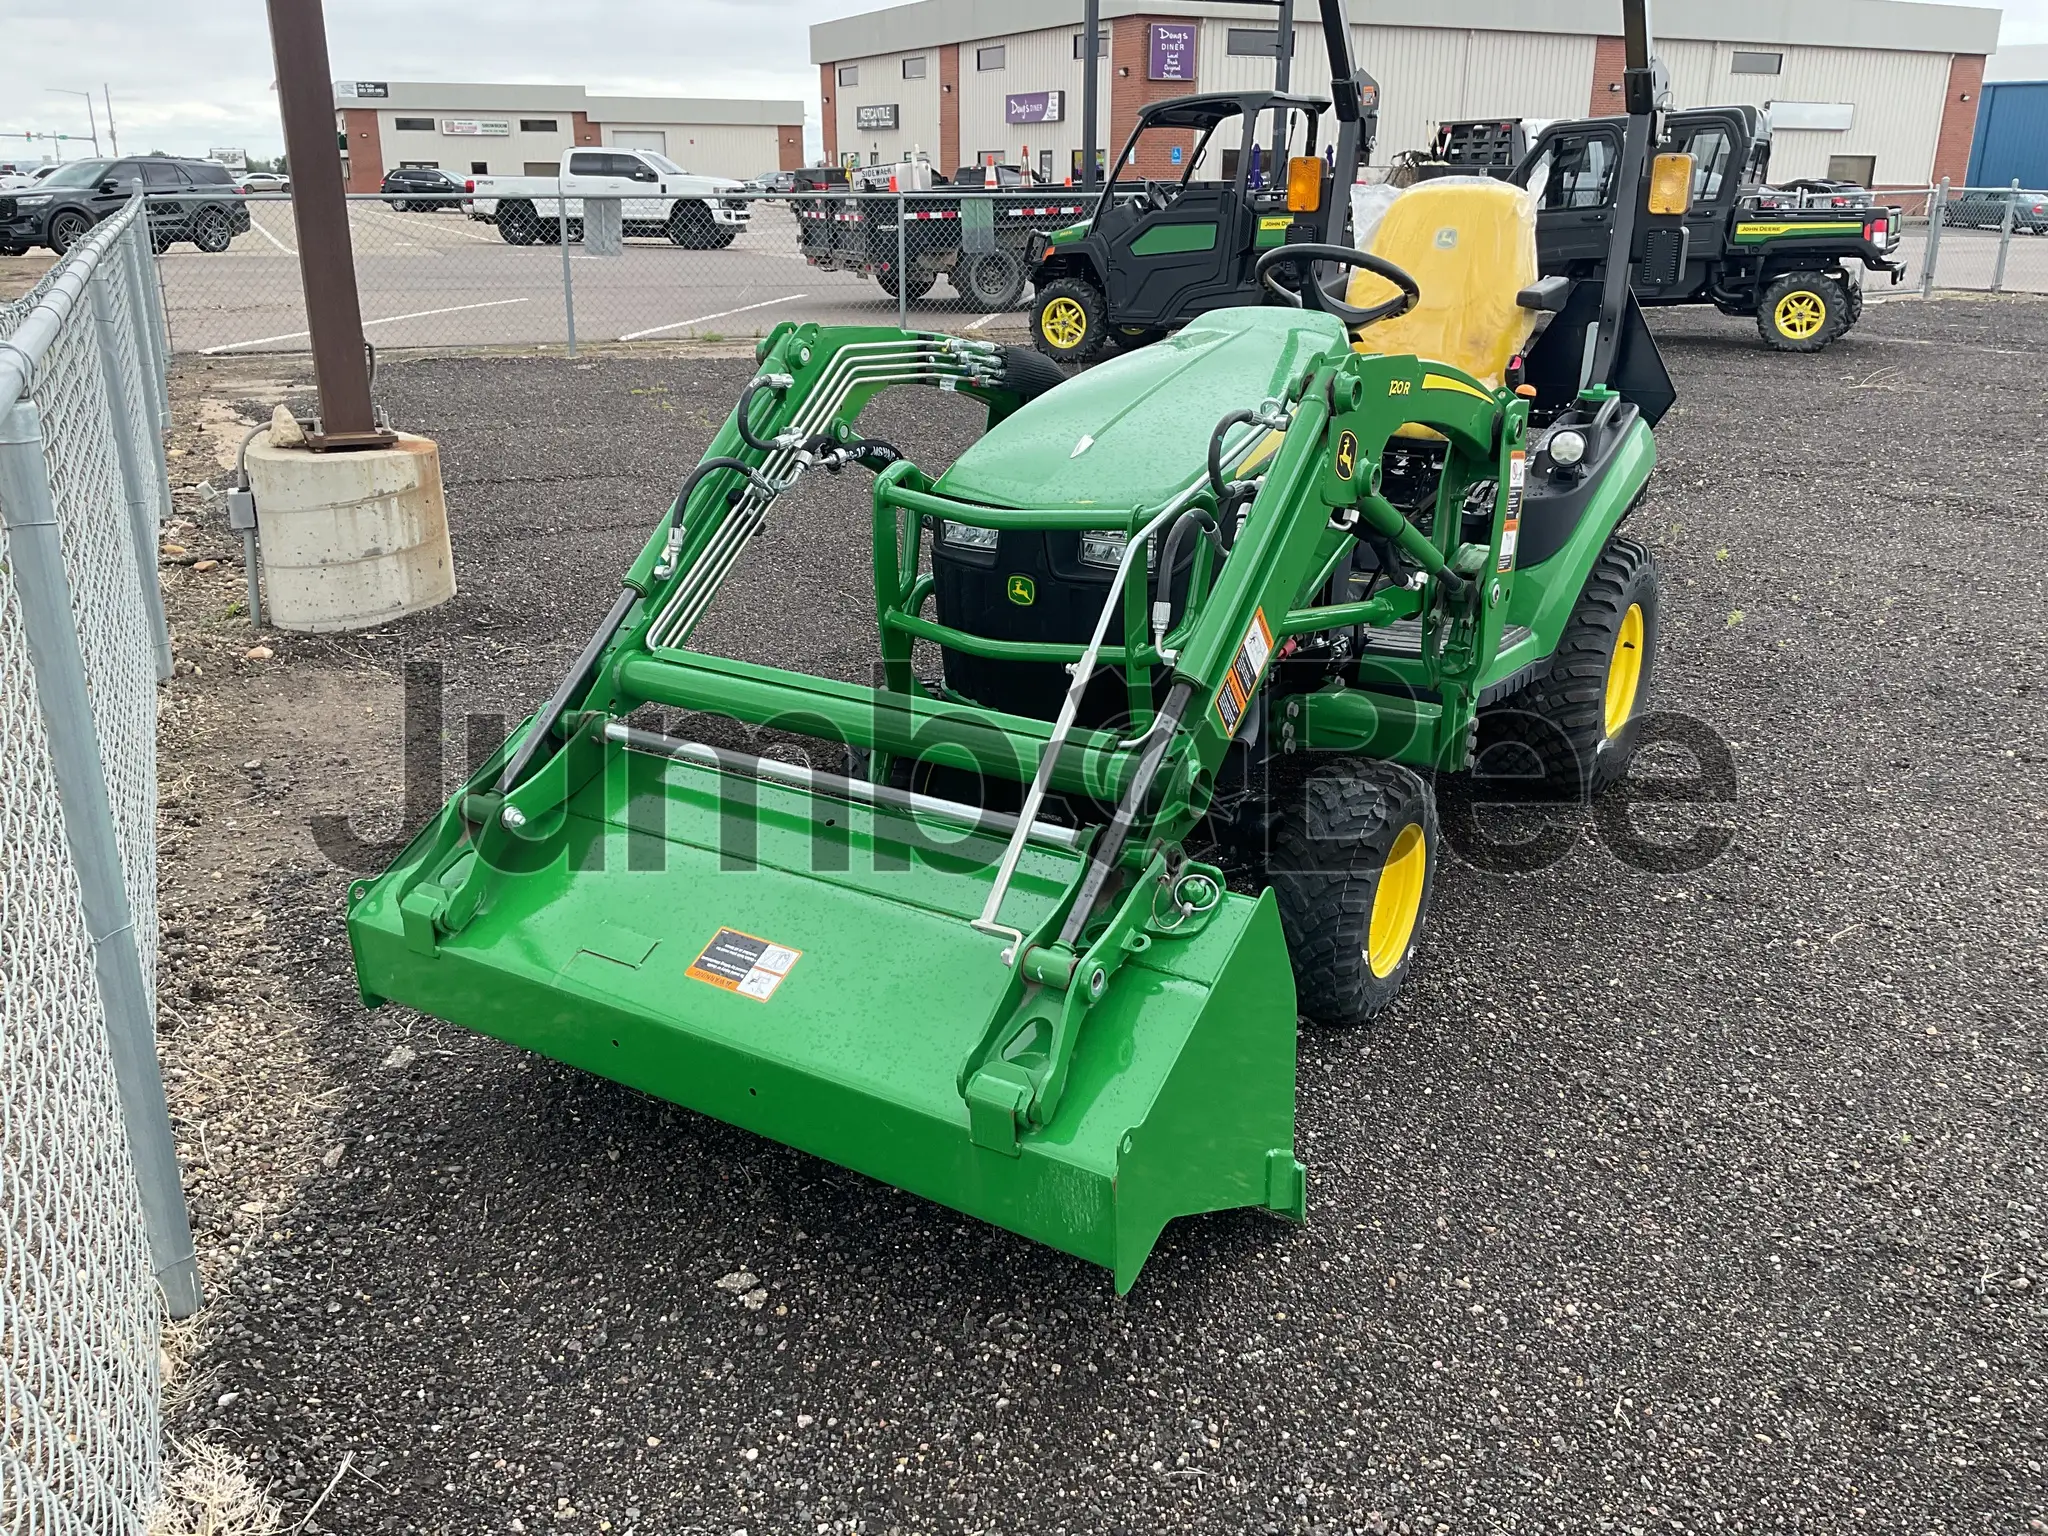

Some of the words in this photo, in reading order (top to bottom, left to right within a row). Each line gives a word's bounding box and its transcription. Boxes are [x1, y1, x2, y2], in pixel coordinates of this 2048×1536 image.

[860, 106, 890, 120] MERCANTILE
[1029, 103, 1043, 112] DINER
[861, 167, 892, 178] SIDEWALK
[1388, 379, 1411, 397] 120R
